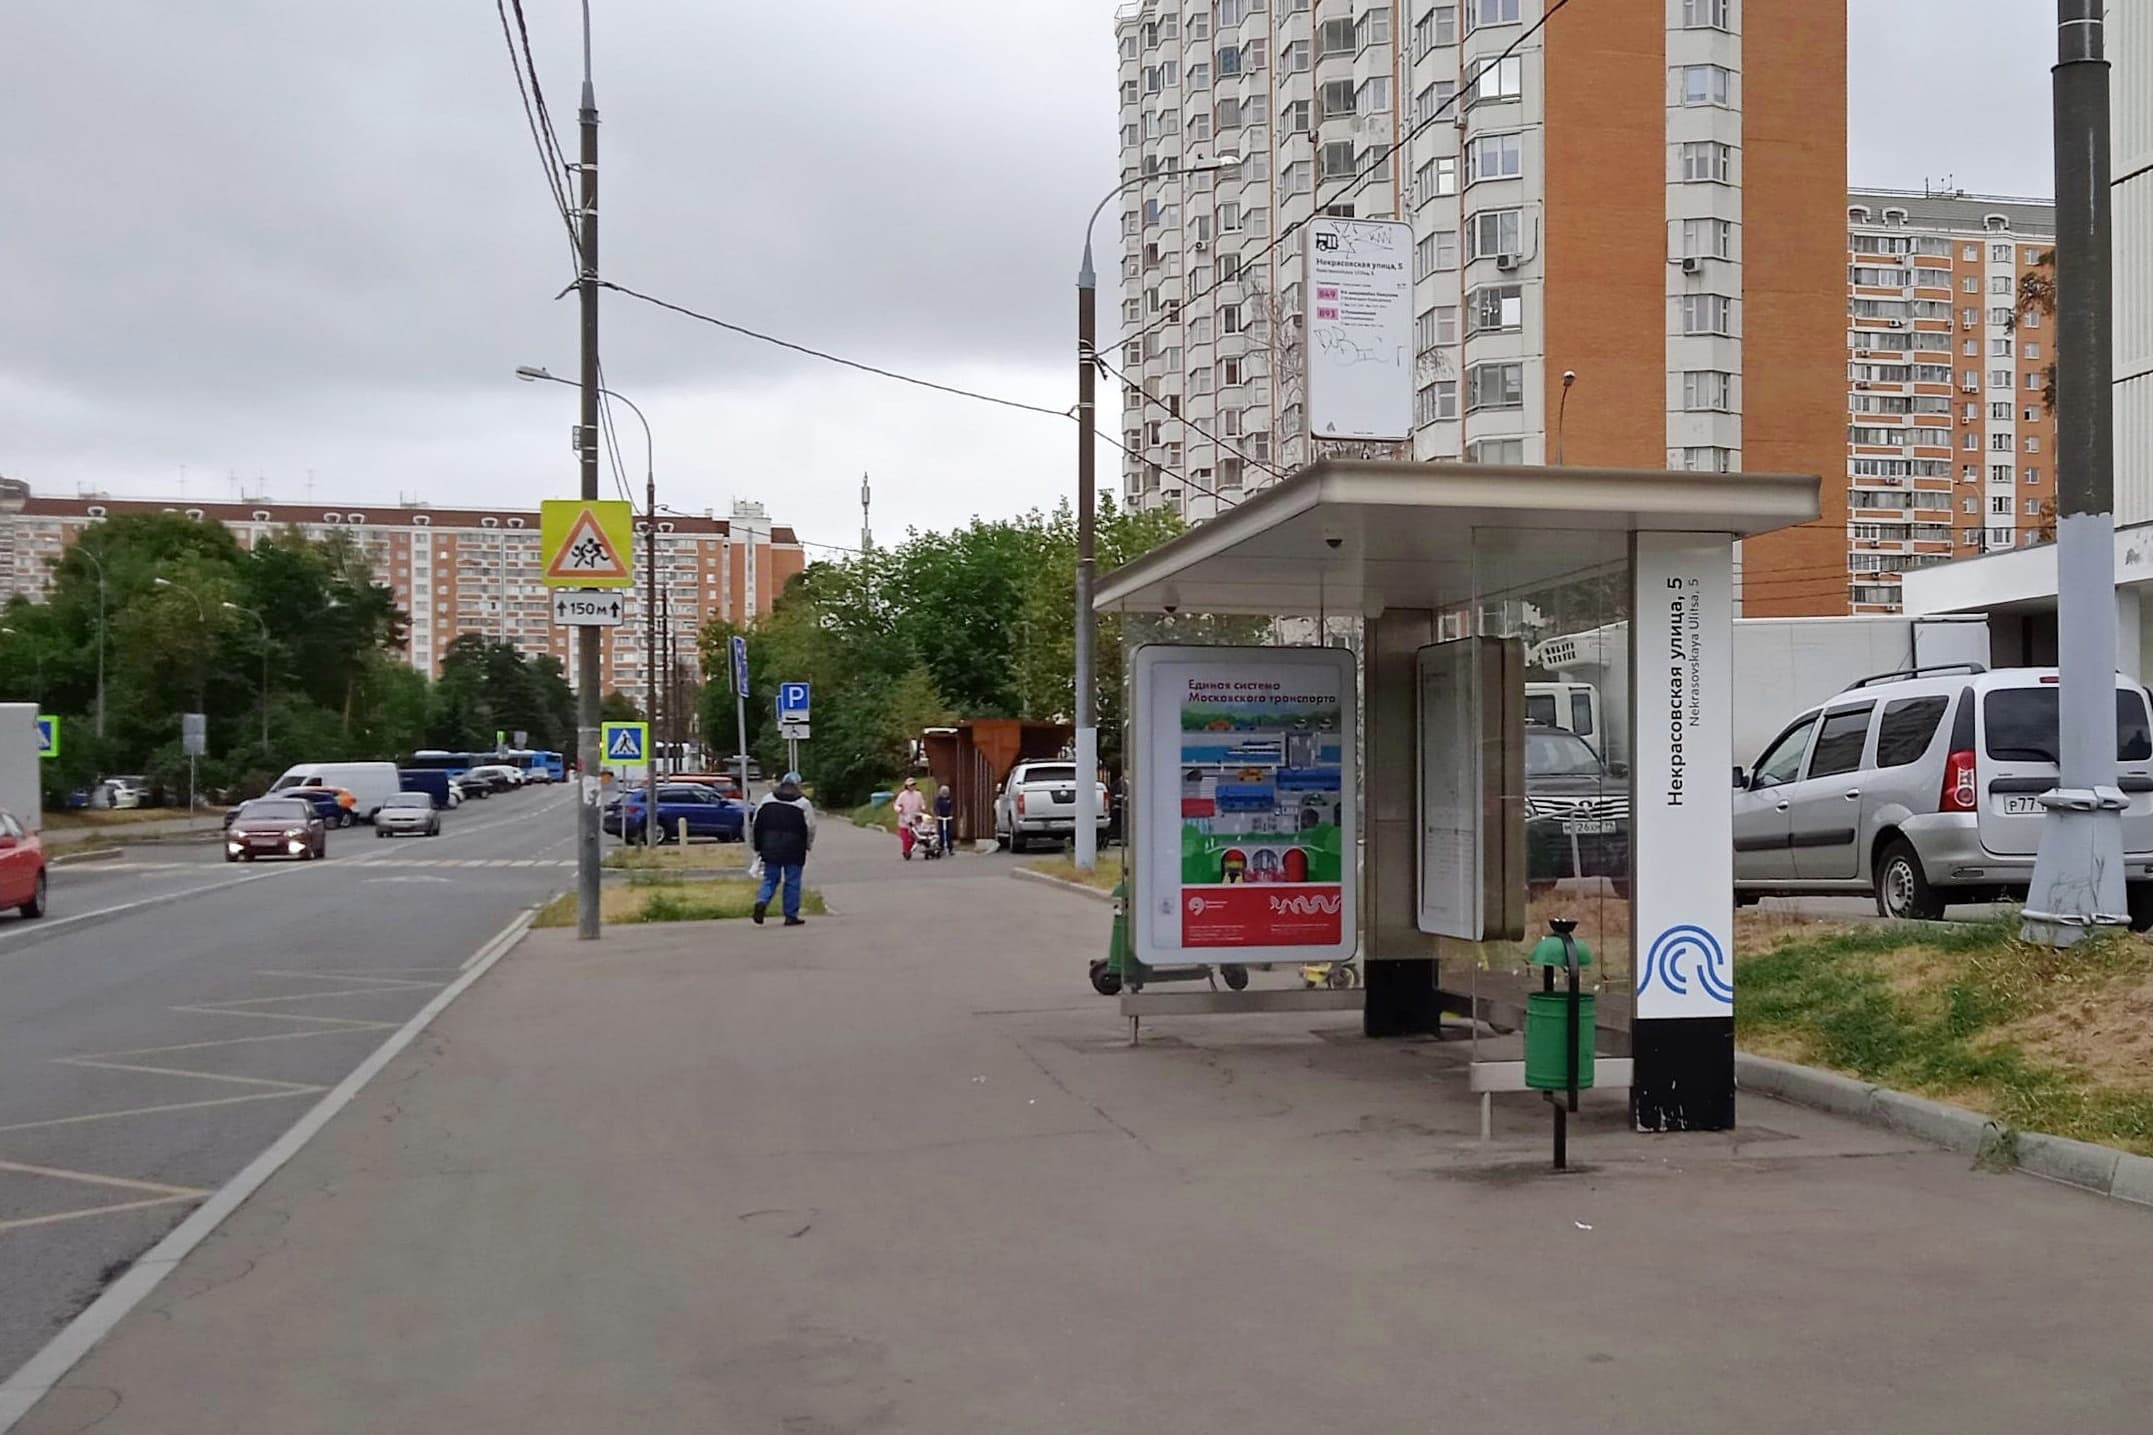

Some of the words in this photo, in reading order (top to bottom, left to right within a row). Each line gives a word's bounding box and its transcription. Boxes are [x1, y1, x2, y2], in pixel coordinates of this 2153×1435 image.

[1667, 577, 1683, 590] 5
[1688, 578, 1699, 587] 5
[1688, 591, 1701, 630] Ulitsa,
[1671, 595, 1686, 660] улица,
[1188, 679, 1231, 691] Единая
[1234, 681, 1281, 691] система
[1689, 633, 1702, 727] Nekrasovskaya
[788, 686, 804, 708] P
[1188, 692, 1266, 703] Московского
[1270, 695, 1336, 705] транспорта
[1667, 666, 1686, 806] Некрасовская
